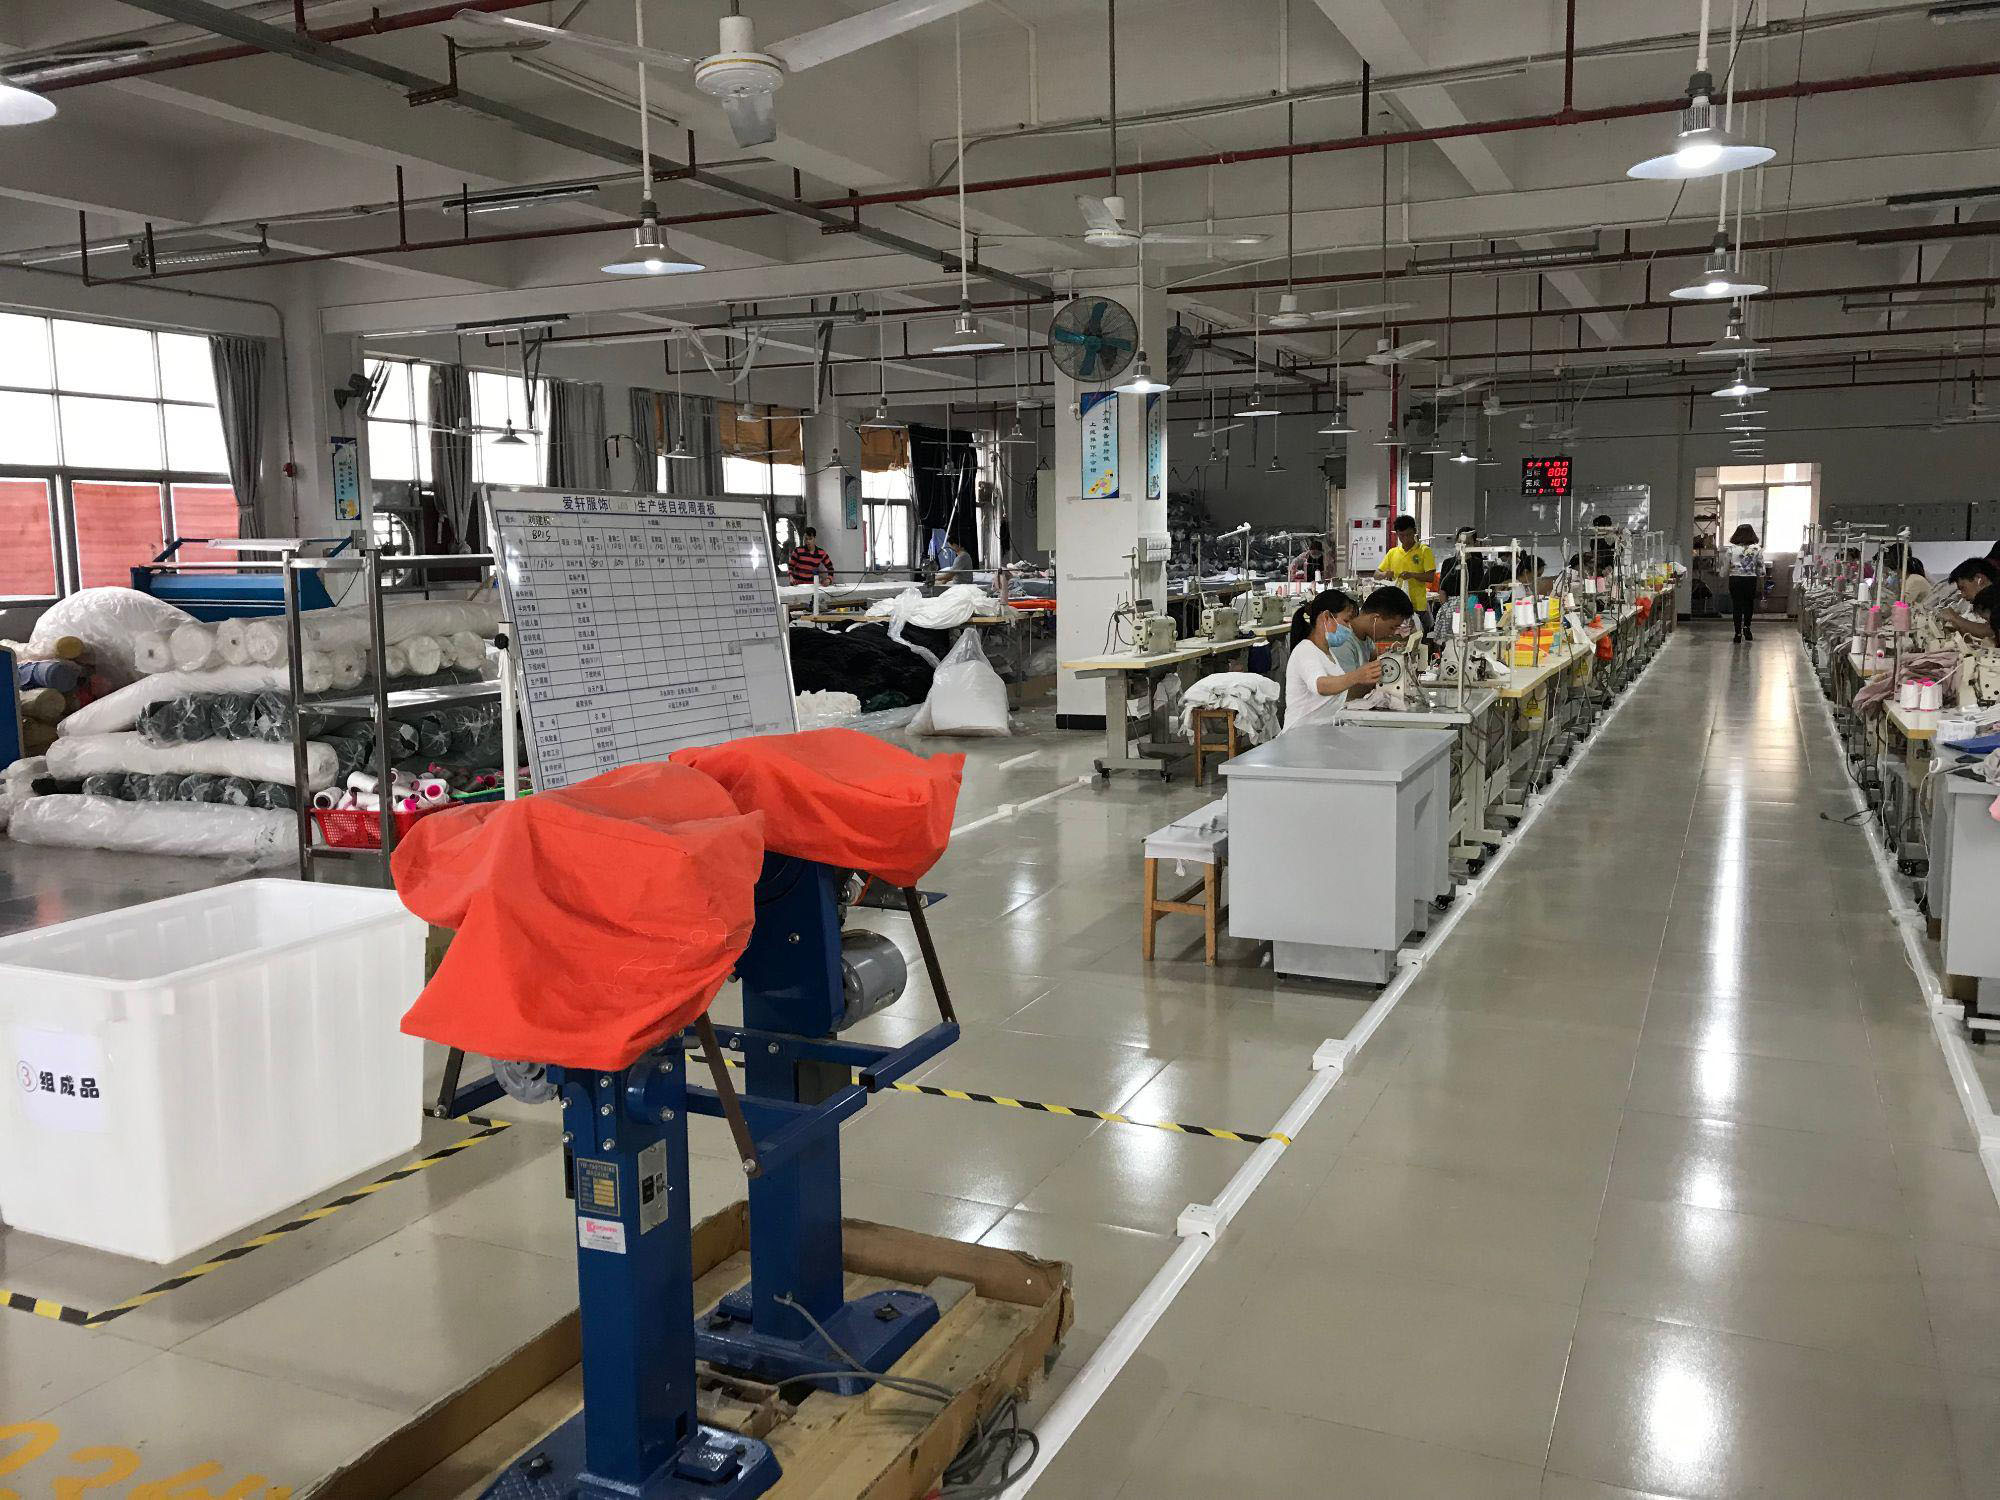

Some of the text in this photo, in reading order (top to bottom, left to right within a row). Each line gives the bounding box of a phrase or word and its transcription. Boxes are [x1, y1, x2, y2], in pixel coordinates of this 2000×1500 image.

[1525, 479, 1541, 487] 完成
[39, 1070, 100, 1099] 组成品
